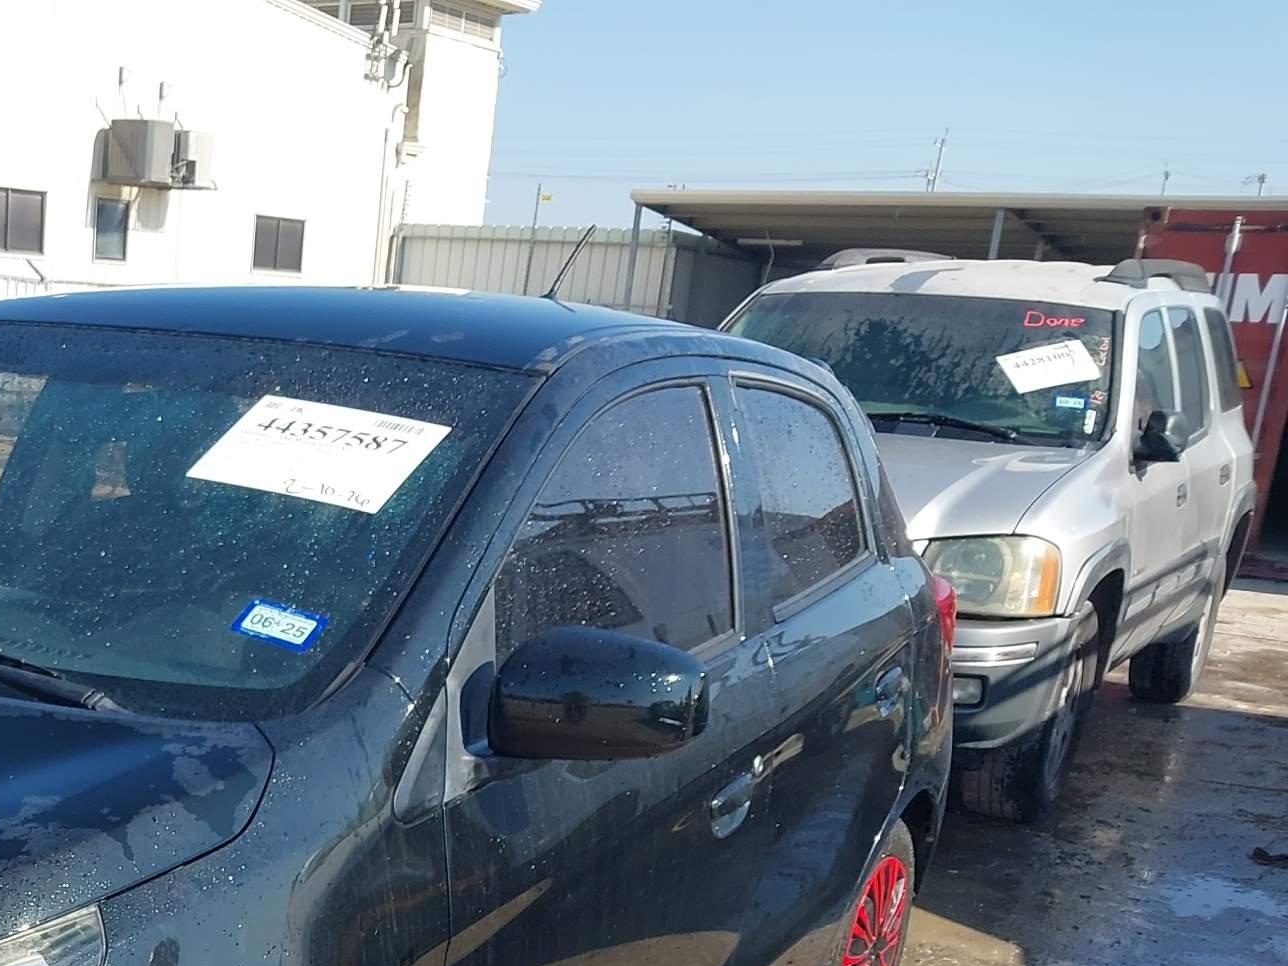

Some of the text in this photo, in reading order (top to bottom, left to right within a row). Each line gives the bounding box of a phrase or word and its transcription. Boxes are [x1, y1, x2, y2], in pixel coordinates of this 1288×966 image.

[1023, 310, 1086, 327] Done
[257, 417, 409, 455] 44357587
[249, 613, 308, 639] 06 25
